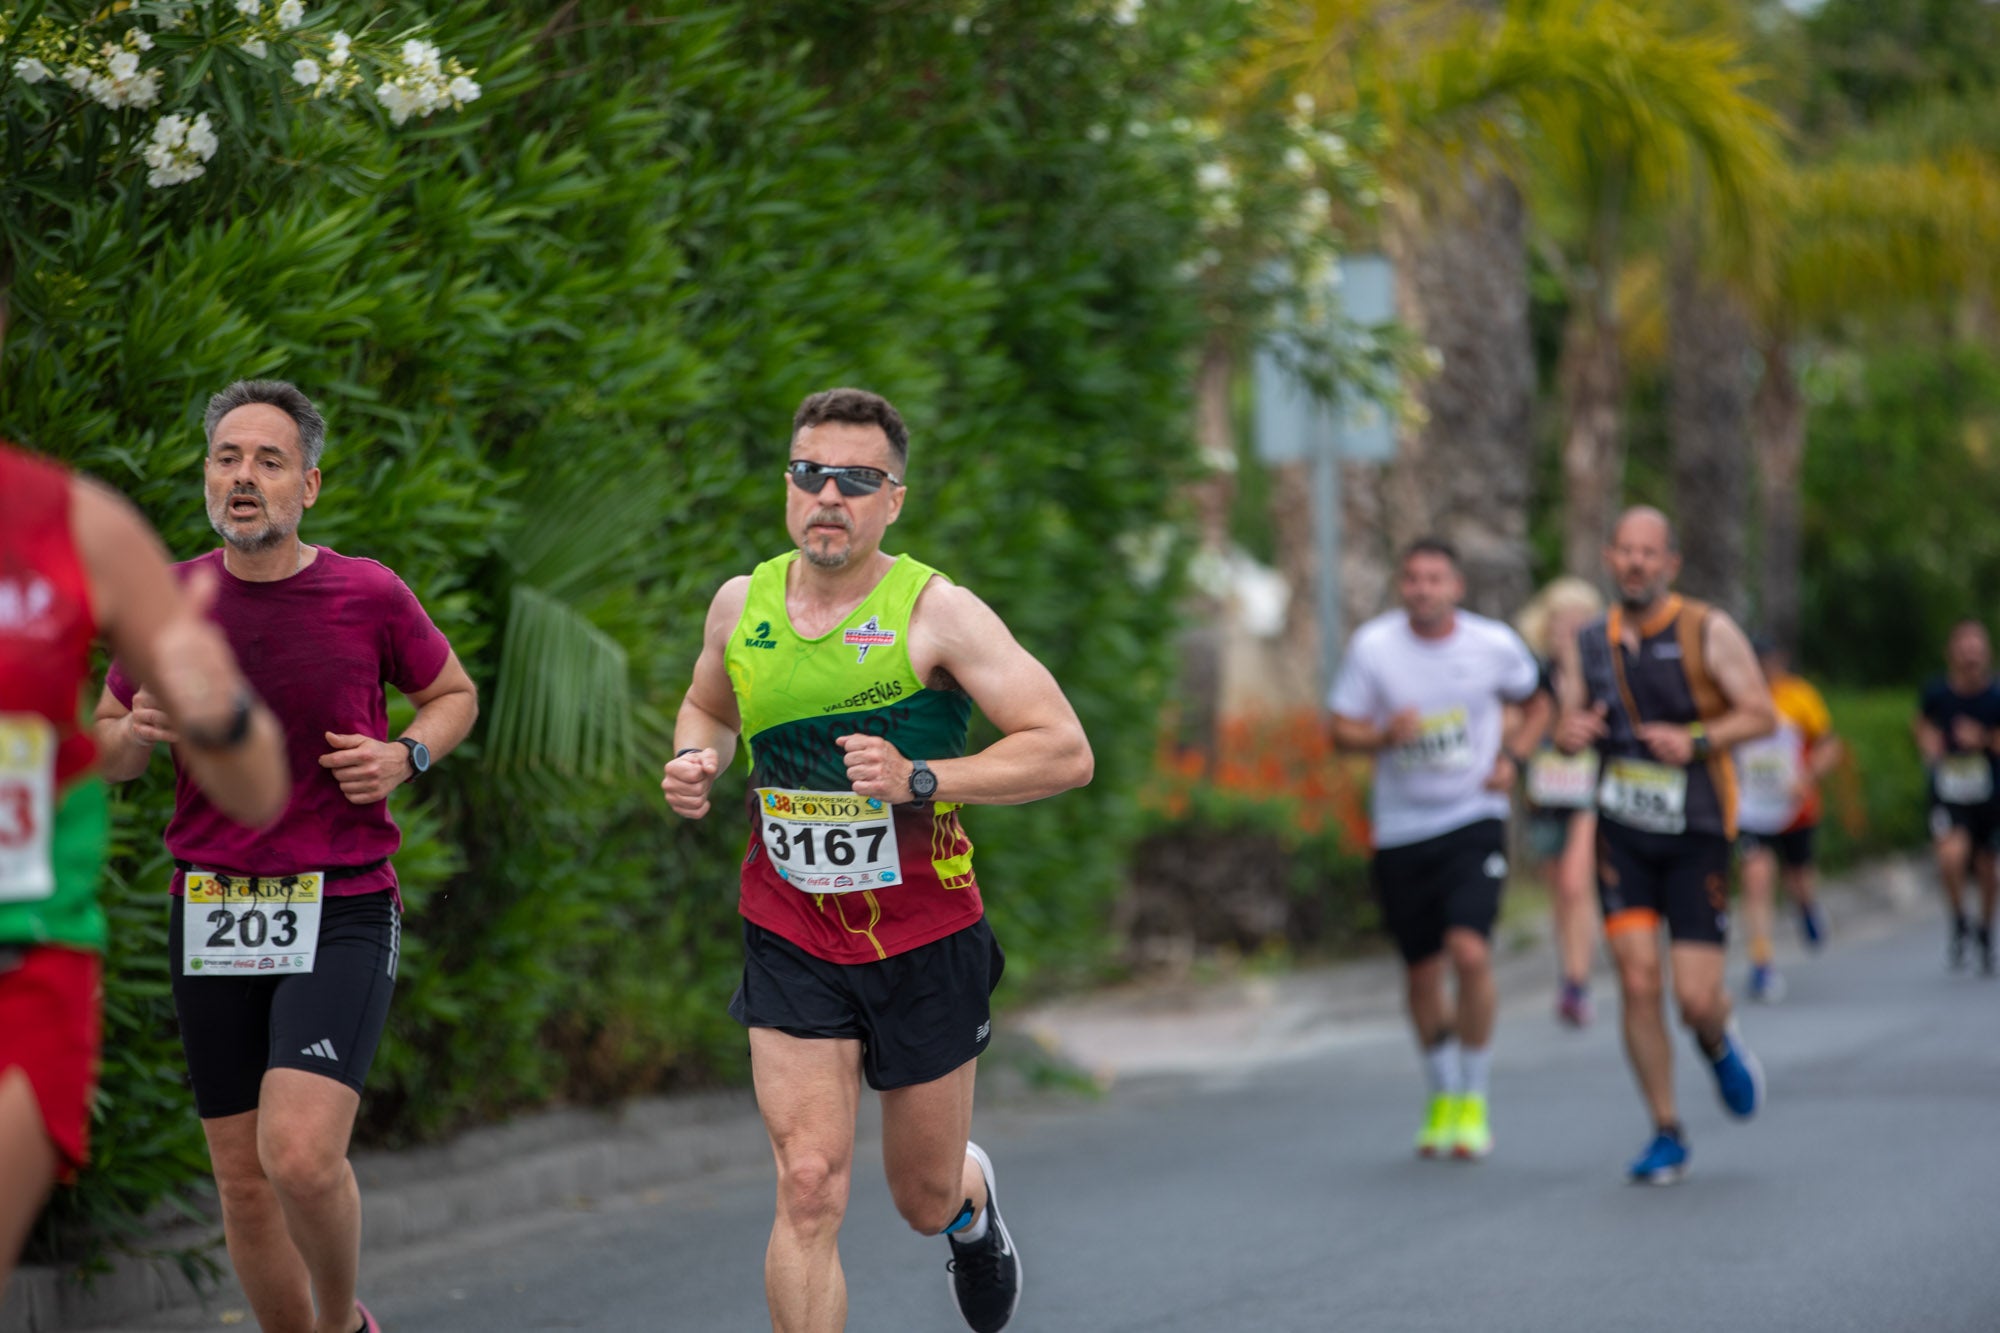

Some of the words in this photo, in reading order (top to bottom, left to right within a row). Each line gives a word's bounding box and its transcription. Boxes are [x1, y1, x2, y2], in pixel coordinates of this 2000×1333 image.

[822, 680, 903, 713] VALDEPEÑAS
[791, 803, 860, 817] FONDO
[768, 822, 888, 866] 3167
[206, 909, 298, 948] 203
